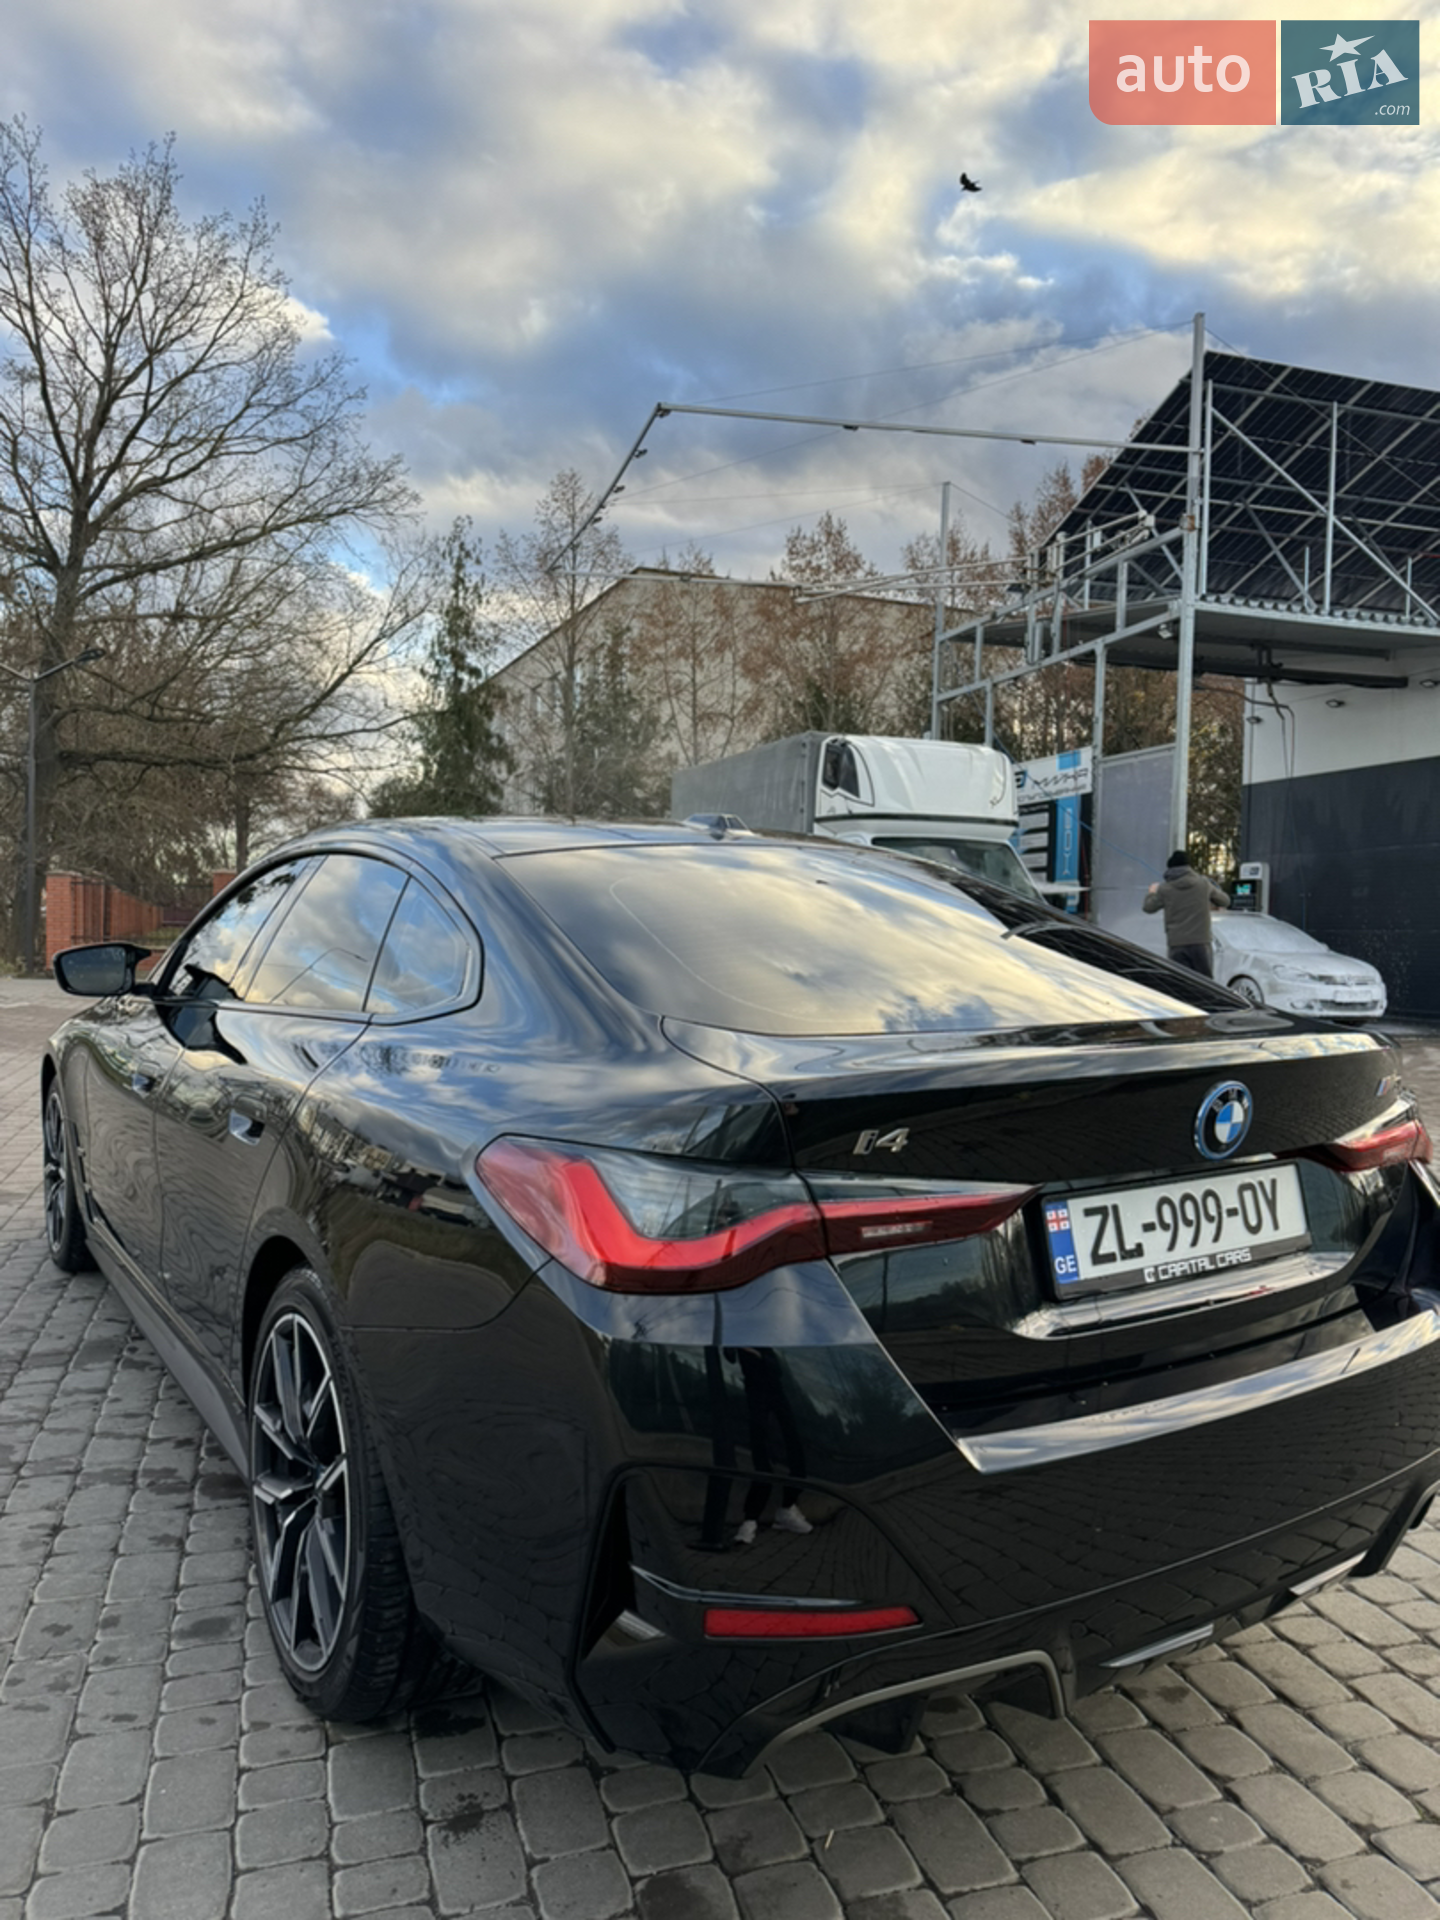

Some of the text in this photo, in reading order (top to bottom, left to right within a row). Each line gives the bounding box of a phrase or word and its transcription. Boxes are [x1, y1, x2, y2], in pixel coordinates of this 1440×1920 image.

[1083, 1177, 1281, 1267] ZL-999-OY
[1054, 1255, 1078, 1275] GE
[1158, 1256, 1215, 1280] CAPITAL
[1216, 1247, 1253, 1268] CARS
